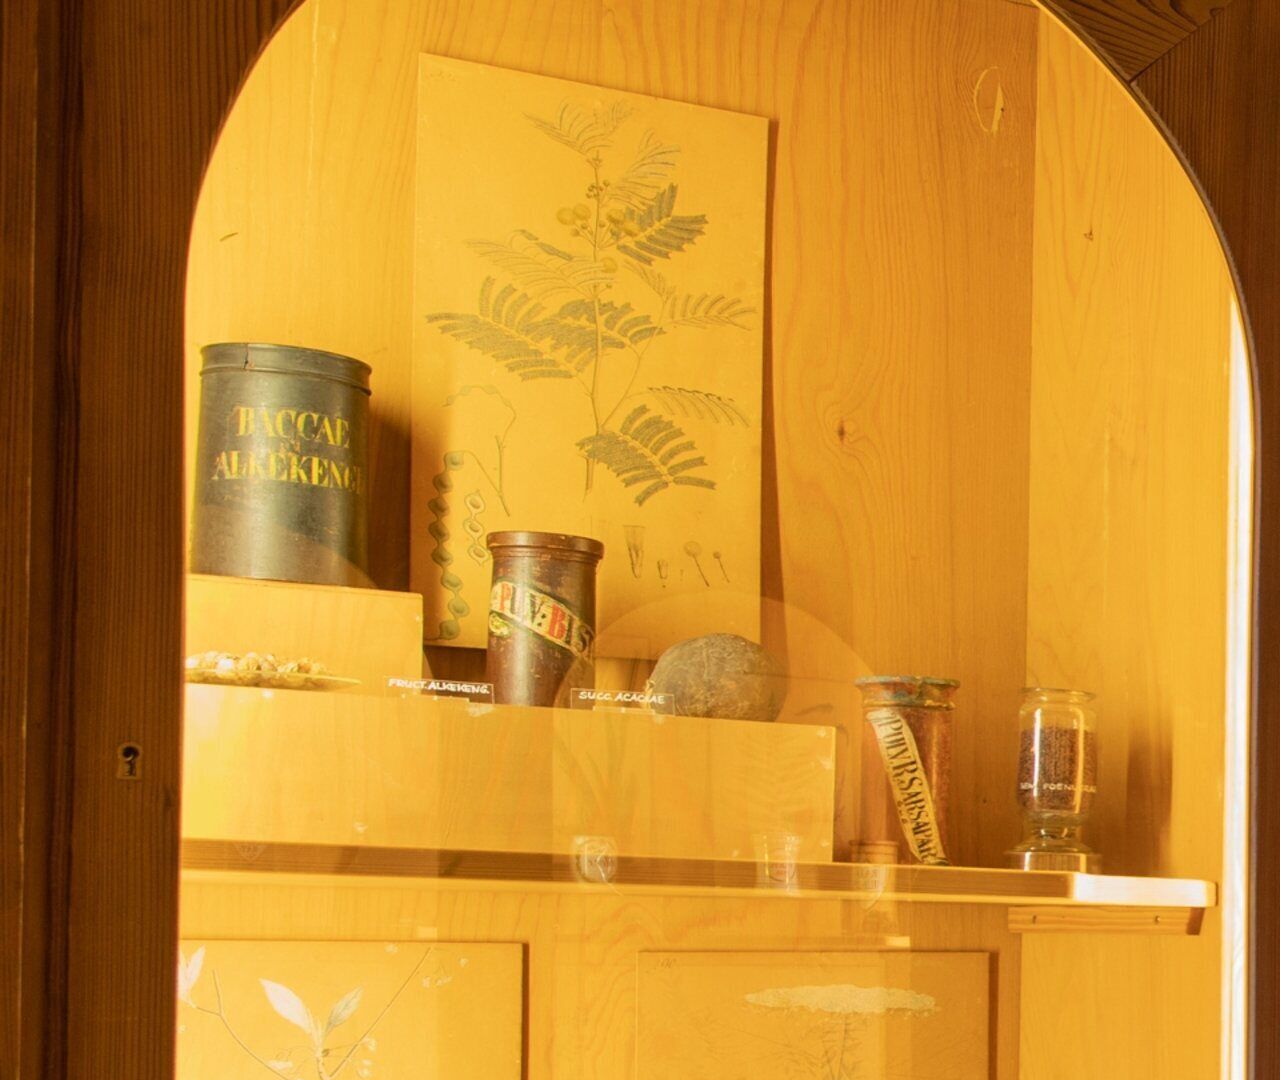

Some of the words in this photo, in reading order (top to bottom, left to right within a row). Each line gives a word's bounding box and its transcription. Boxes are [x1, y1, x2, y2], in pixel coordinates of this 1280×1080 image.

[236, 406, 351, 449] BACCAE
[427, 679, 491, 695] ALKEKENG.
[578, 690, 612, 702] SUCC.
